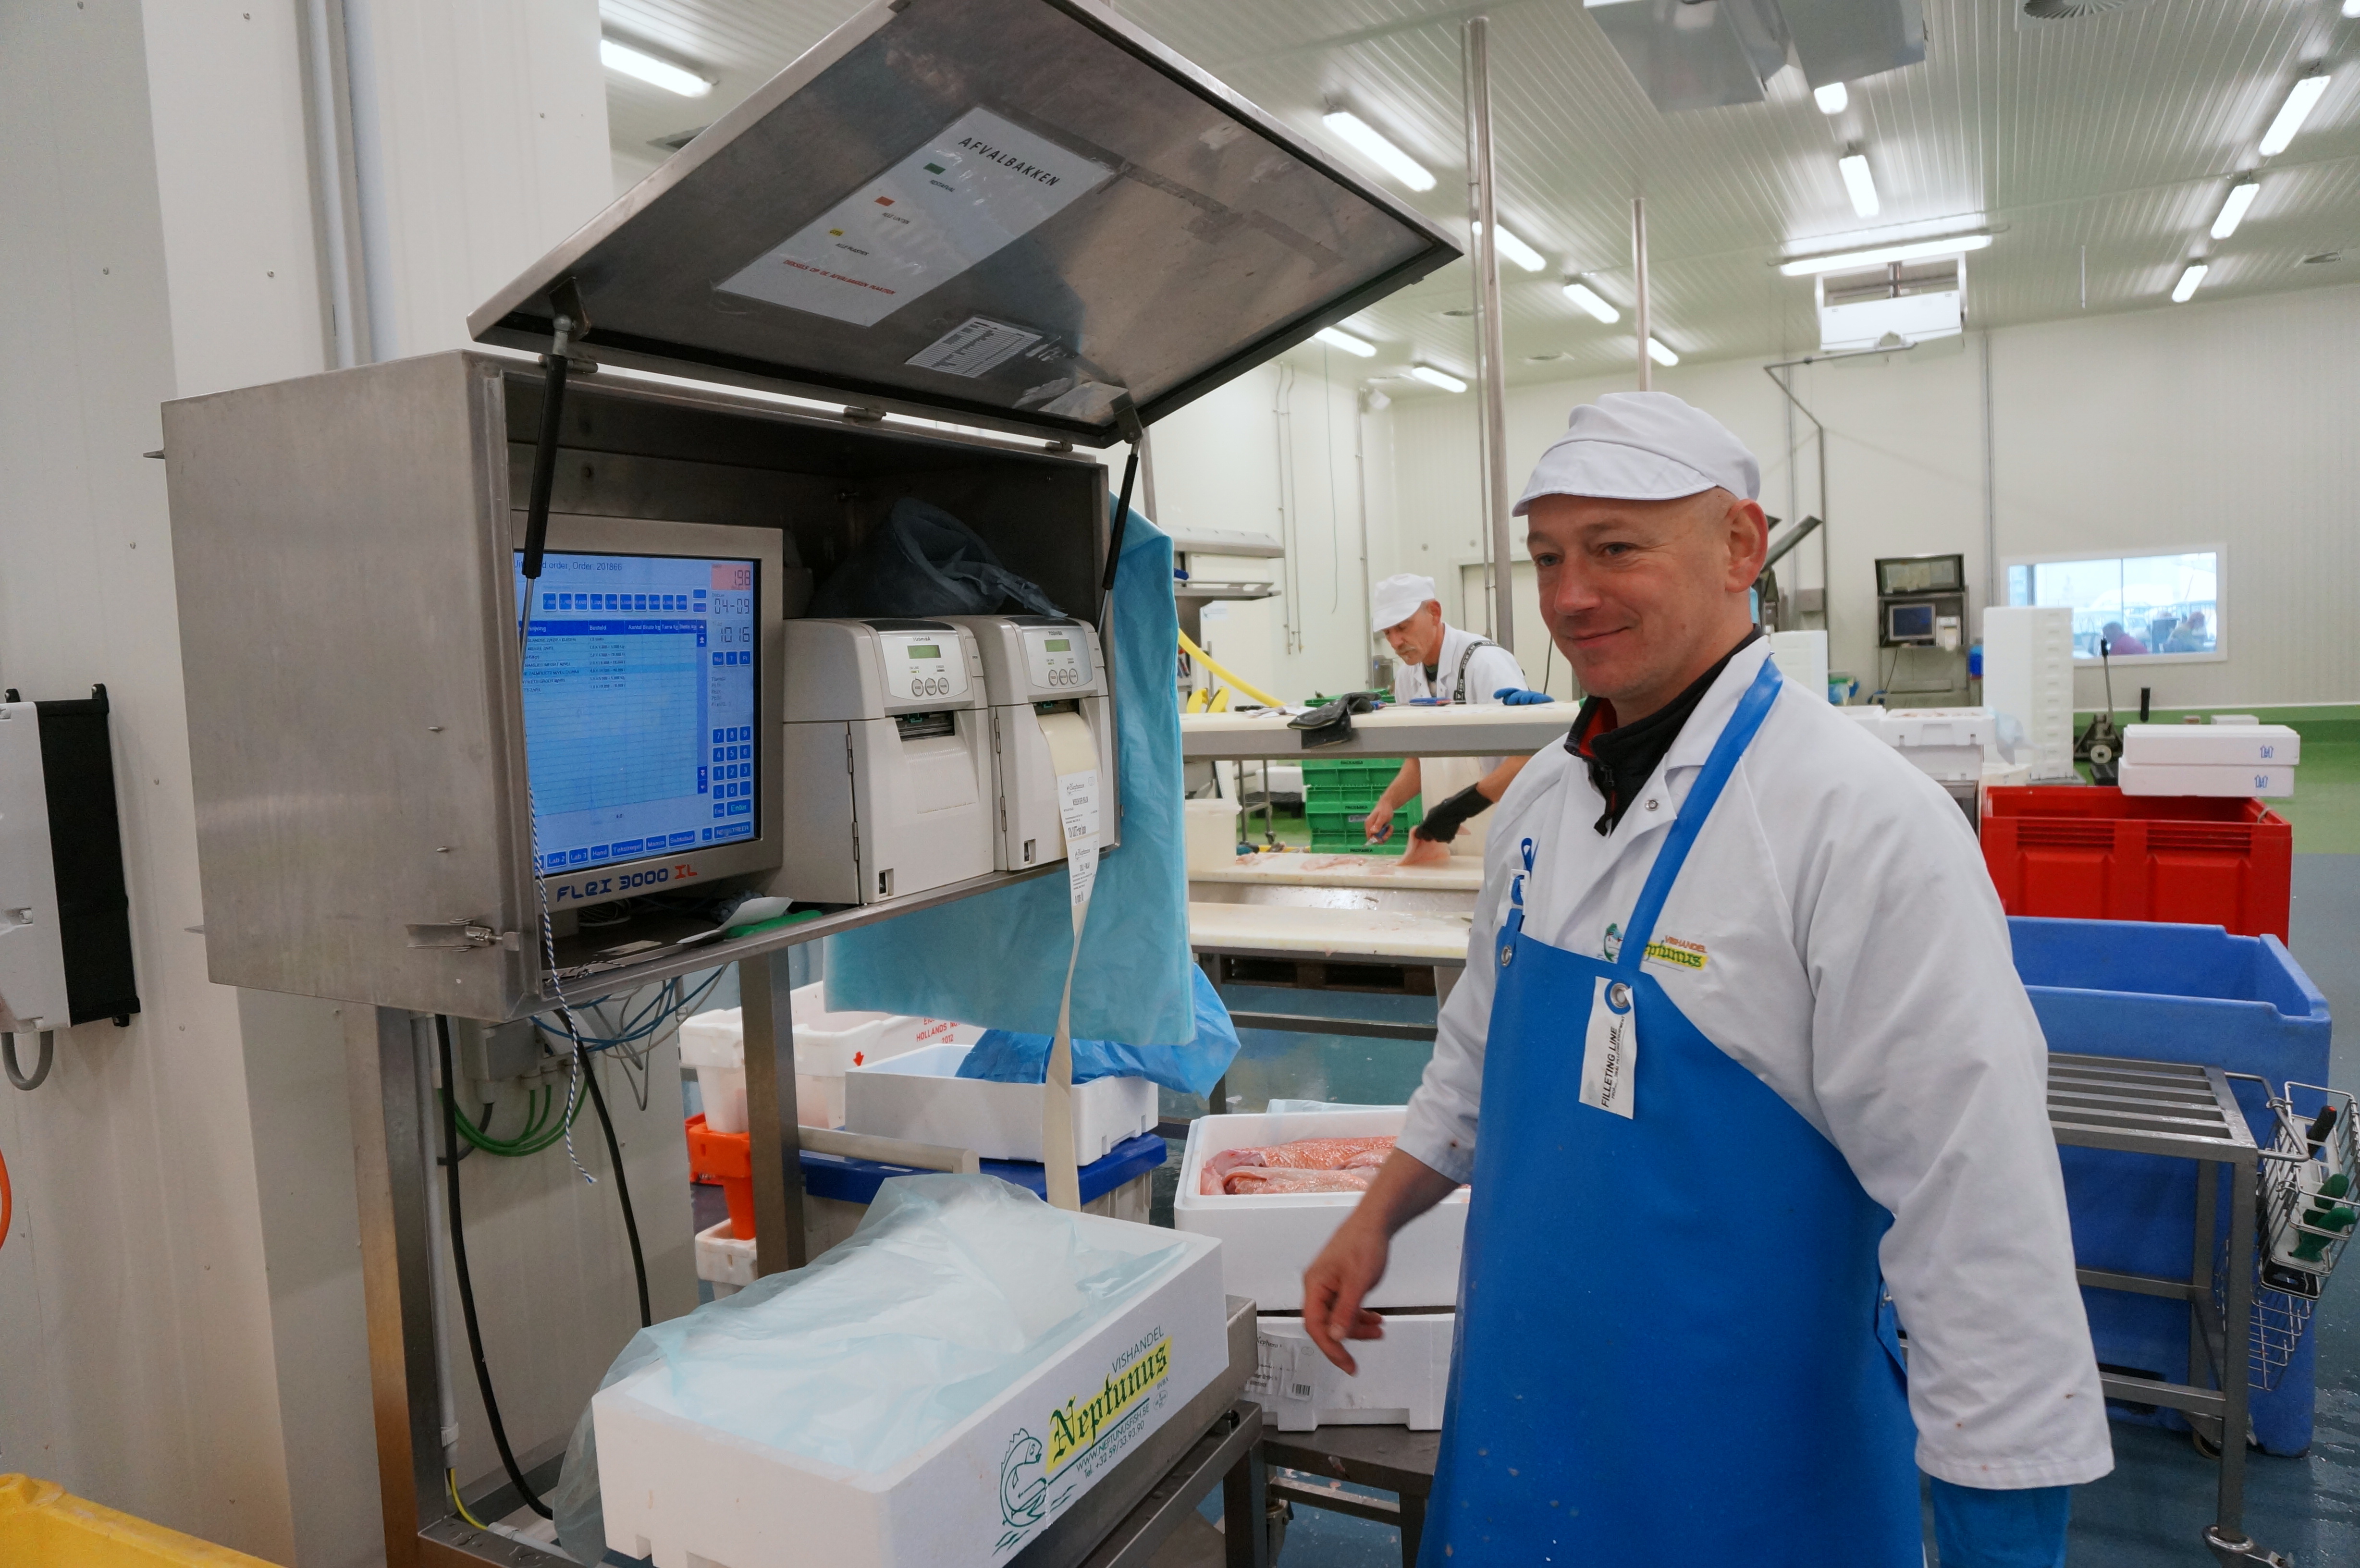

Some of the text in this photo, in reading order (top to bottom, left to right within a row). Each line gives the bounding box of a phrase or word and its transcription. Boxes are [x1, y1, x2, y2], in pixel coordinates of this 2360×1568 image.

[958, 137, 1060, 186] AFVALBAKKEN
[597, 563, 622, 571] 201866
[714, 598, 750, 614] 04-09
[619, 868, 668, 890] 3000
[916, 1023, 947, 1042] HOLLANDS
[942, 1034, 954, 1043] 2012
[1601, 1026, 1618, 1108] FILLETING LINE
[1112, 1325, 1164, 1373] VISHANDEL
[1050, 1343, 1168, 1463] Neptunus
[1095, 1453, 1107, 1469] +32
